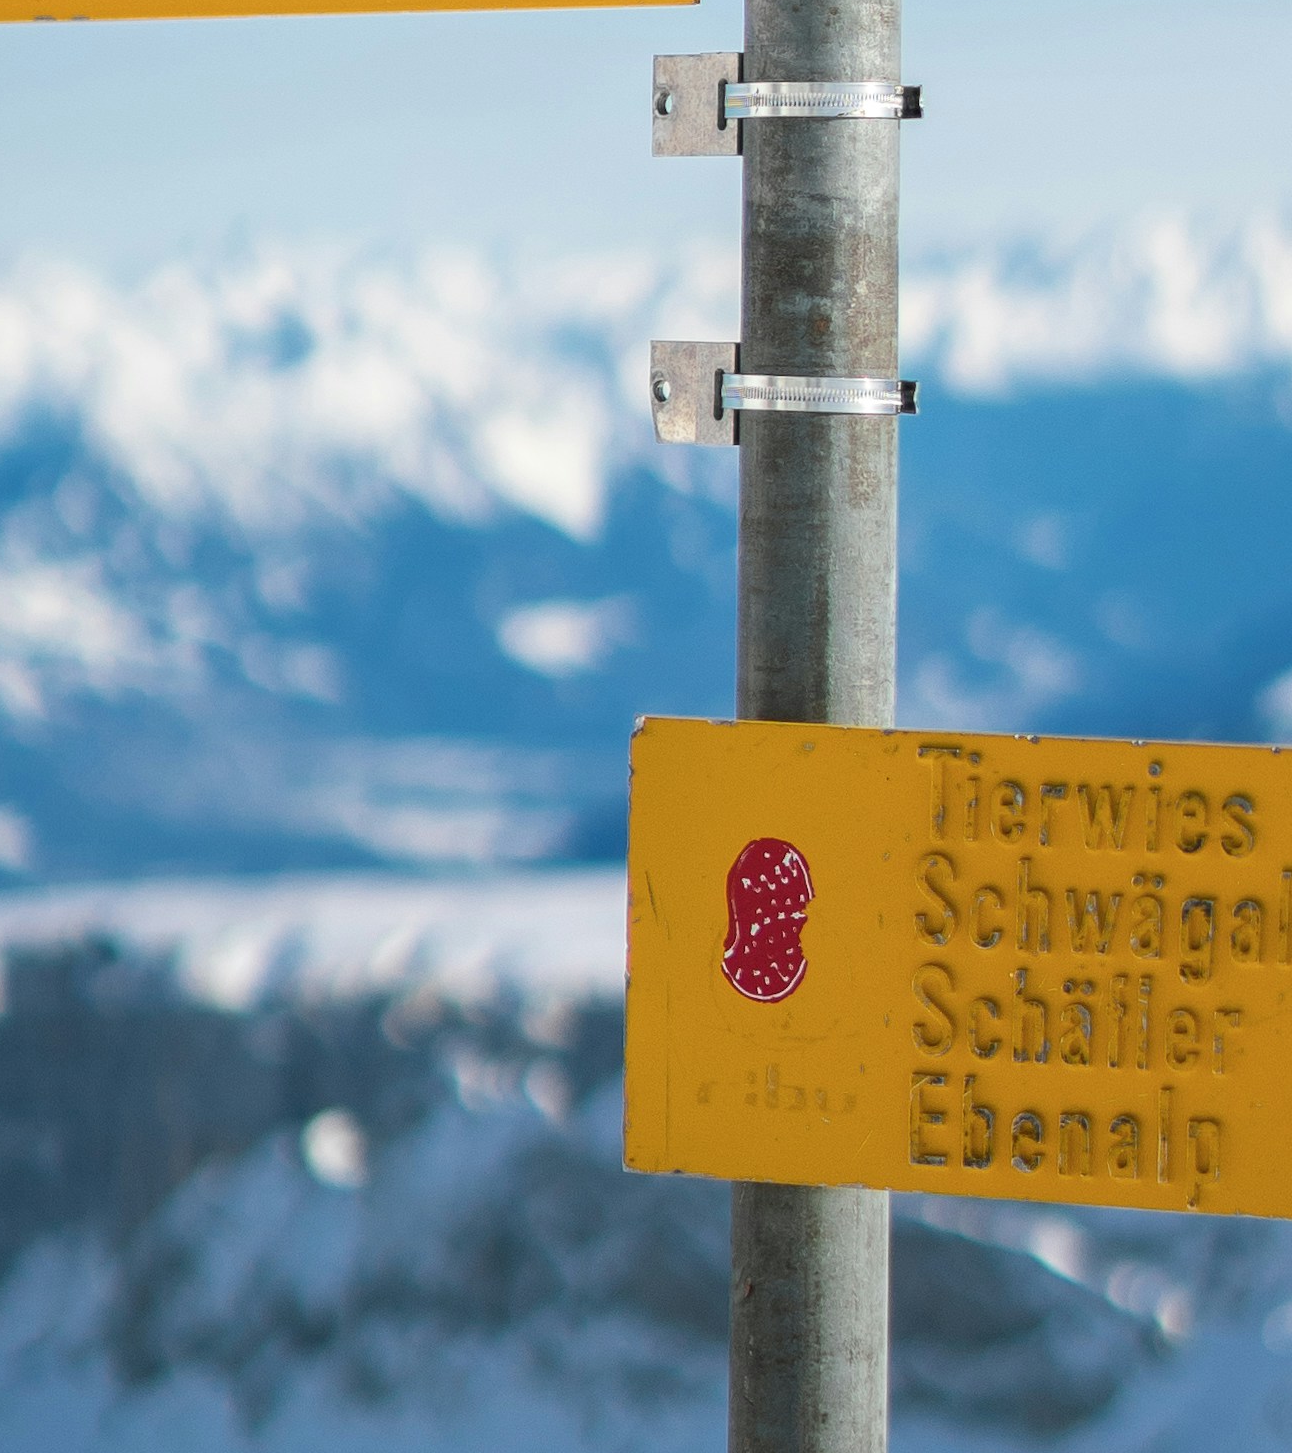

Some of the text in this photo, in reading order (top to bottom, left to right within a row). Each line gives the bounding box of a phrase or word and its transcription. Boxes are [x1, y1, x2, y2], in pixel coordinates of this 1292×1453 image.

[917, 745, 1256, 858] Tierwies
[913, 963, 1240, 1076] Schäfler
[909, 1073, 1221, 1208] Ebenalp
